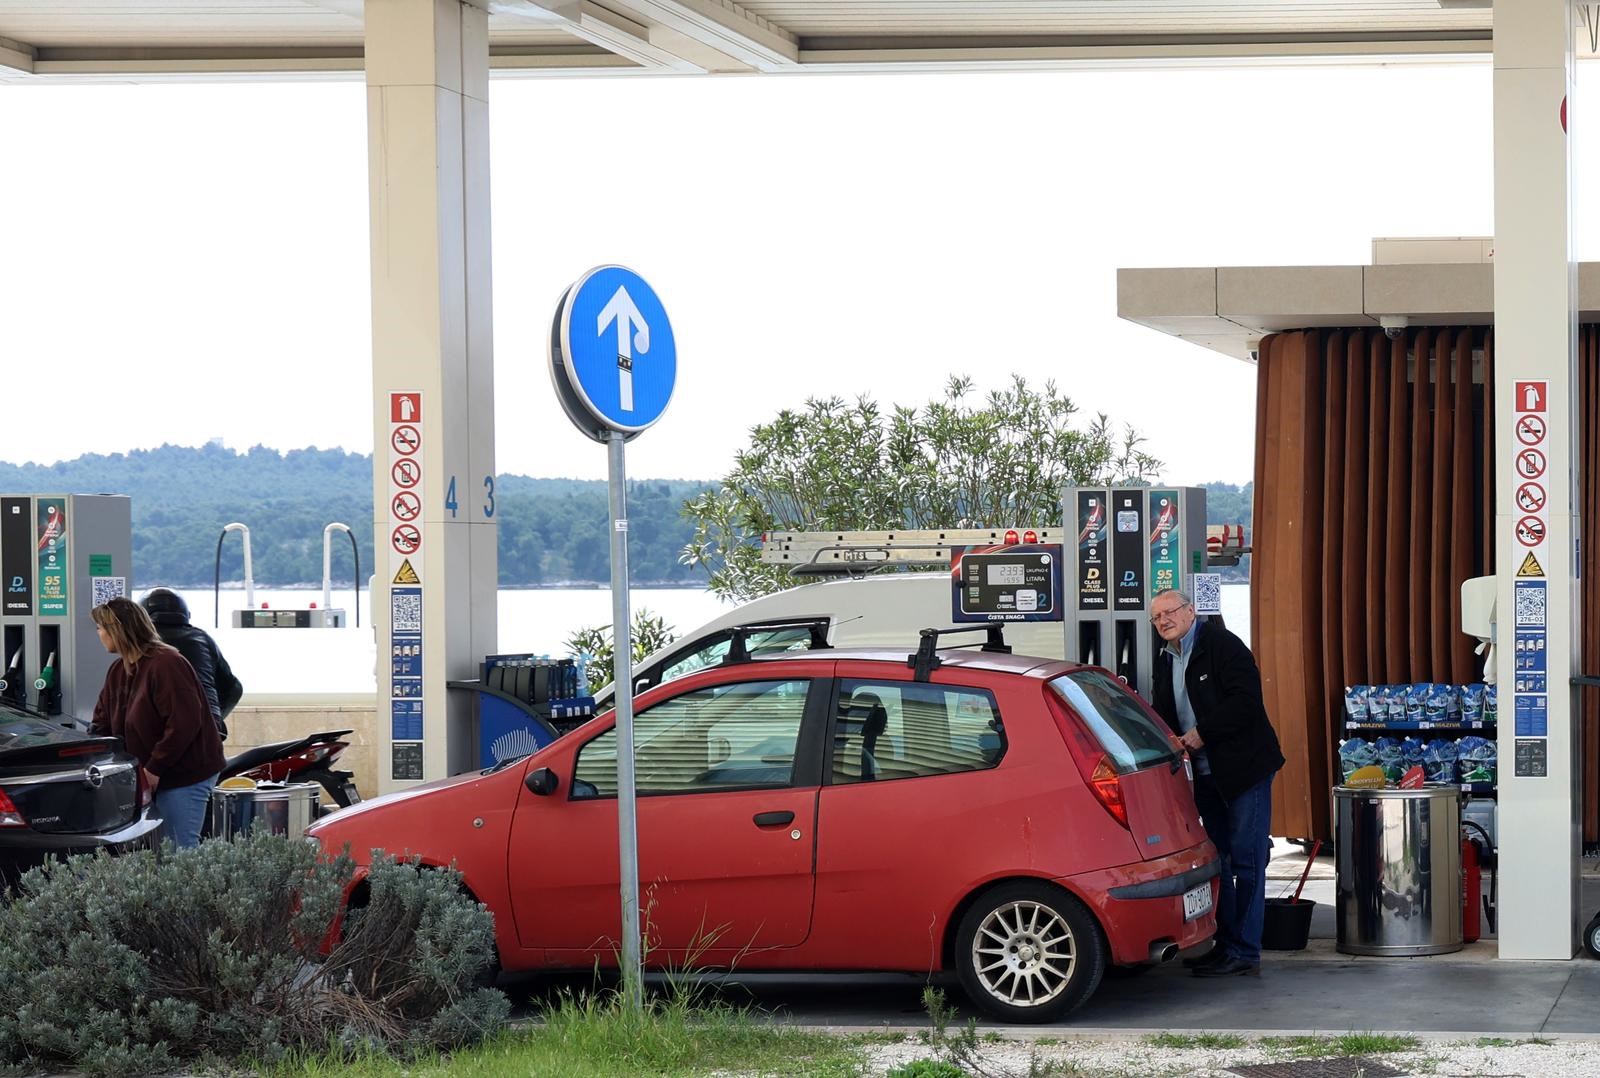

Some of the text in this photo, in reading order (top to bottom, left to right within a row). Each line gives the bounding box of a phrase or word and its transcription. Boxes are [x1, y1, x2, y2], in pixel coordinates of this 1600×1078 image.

[445, 475, 458, 518] 4
[483, 475, 495, 518] 3
[1087, 568, 1100, 579] D
[1123, 571, 1135, 581] D
[1157, 569, 1173, 580] 95
[12, 576, 23, 587] D
[45, 576, 61, 586] 95
[1038, 593, 1047, 607] 2
